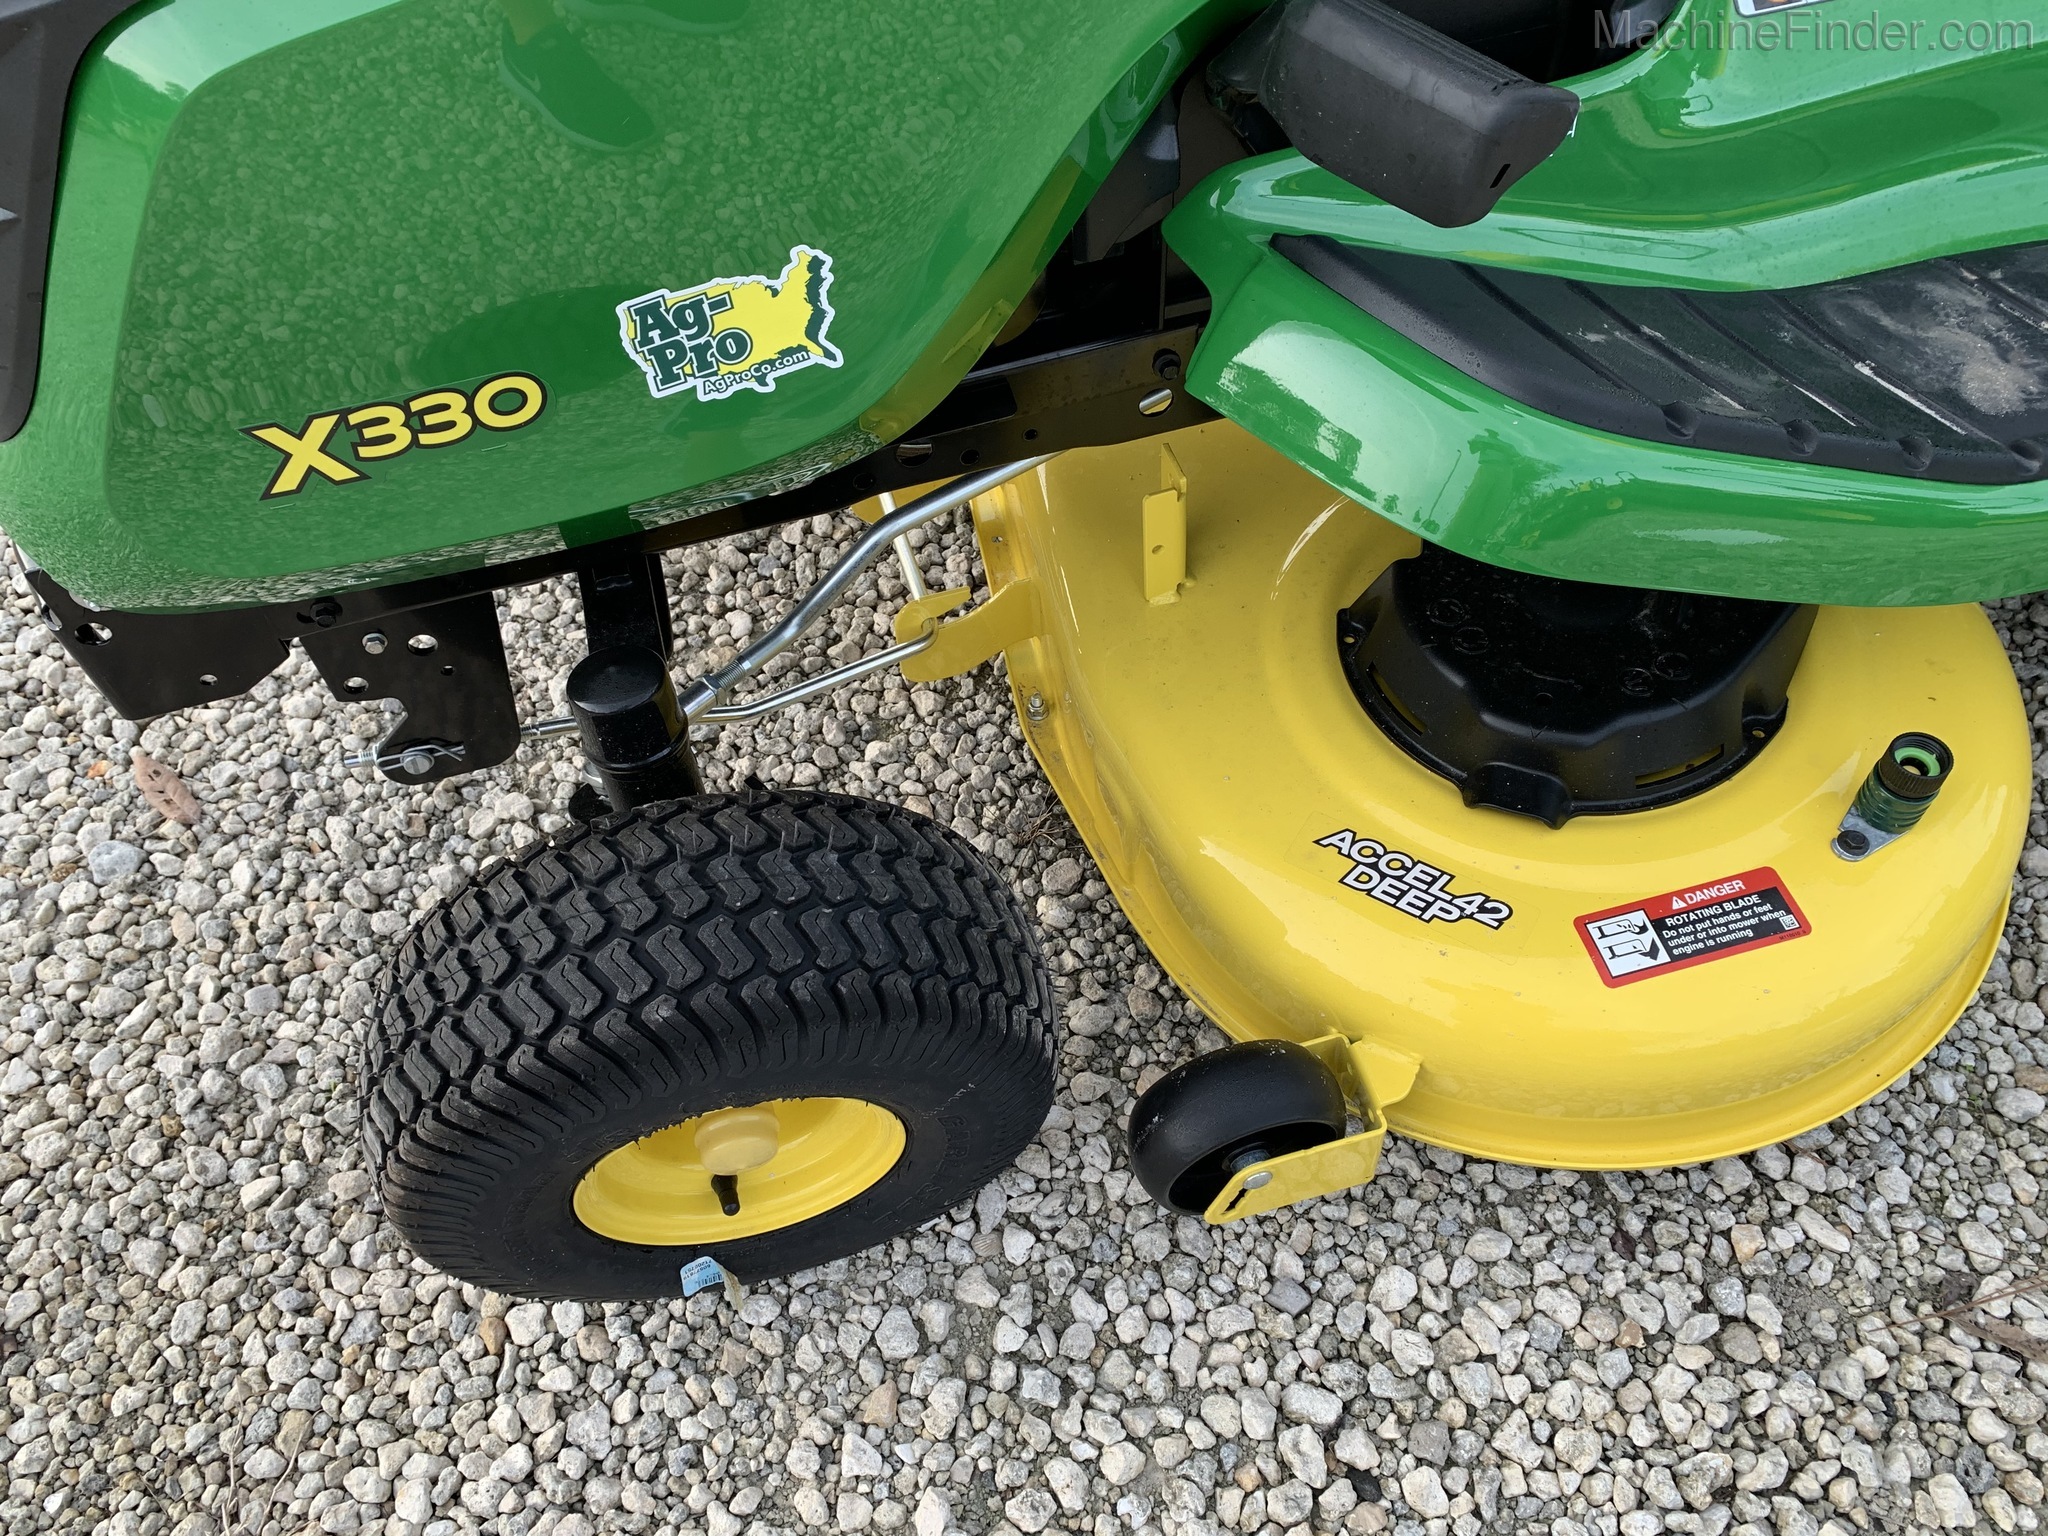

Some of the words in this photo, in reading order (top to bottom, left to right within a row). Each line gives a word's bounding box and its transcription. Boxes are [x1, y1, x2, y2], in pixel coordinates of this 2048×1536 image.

[627, 291, 734, 352] Ag-
[646, 328, 753, 392] Pro
[703, 350, 811, 395] AgProCo.com
[238, 371, 547, 500] X330
[1312, 828, 1456, 901] ACCEL
[1451, 892, 1514, 930] 42
[1338, 862, 1461, 924] DEEP
[1684, 879, 1746, 904] DANGER
[1662, 928, 1678, 939] Do
[1678, 923, 1695, 935] not
[1695, 919, 1713, 932] put
[1713, 911, 1742, 926] hands
[1742, 908, 1754, 917] or
[1753, 902, 1773, 914] feet
[1665, 905, 1723, 927] ROTATING
[1722, 894, 1762, 912] BLADE
[1667, 935, 1696, 947] under
[1695, 930, 1708, 940] or
[1708, 924, 1728, 936] into
[1728, 917, 1761, 931] mower
[1760, 909, 1787, 922] when
[1672, 941, 1706, 956] engine
[1706, 937, 1716, 947] is
[1716, 928, 1754, 944] running
